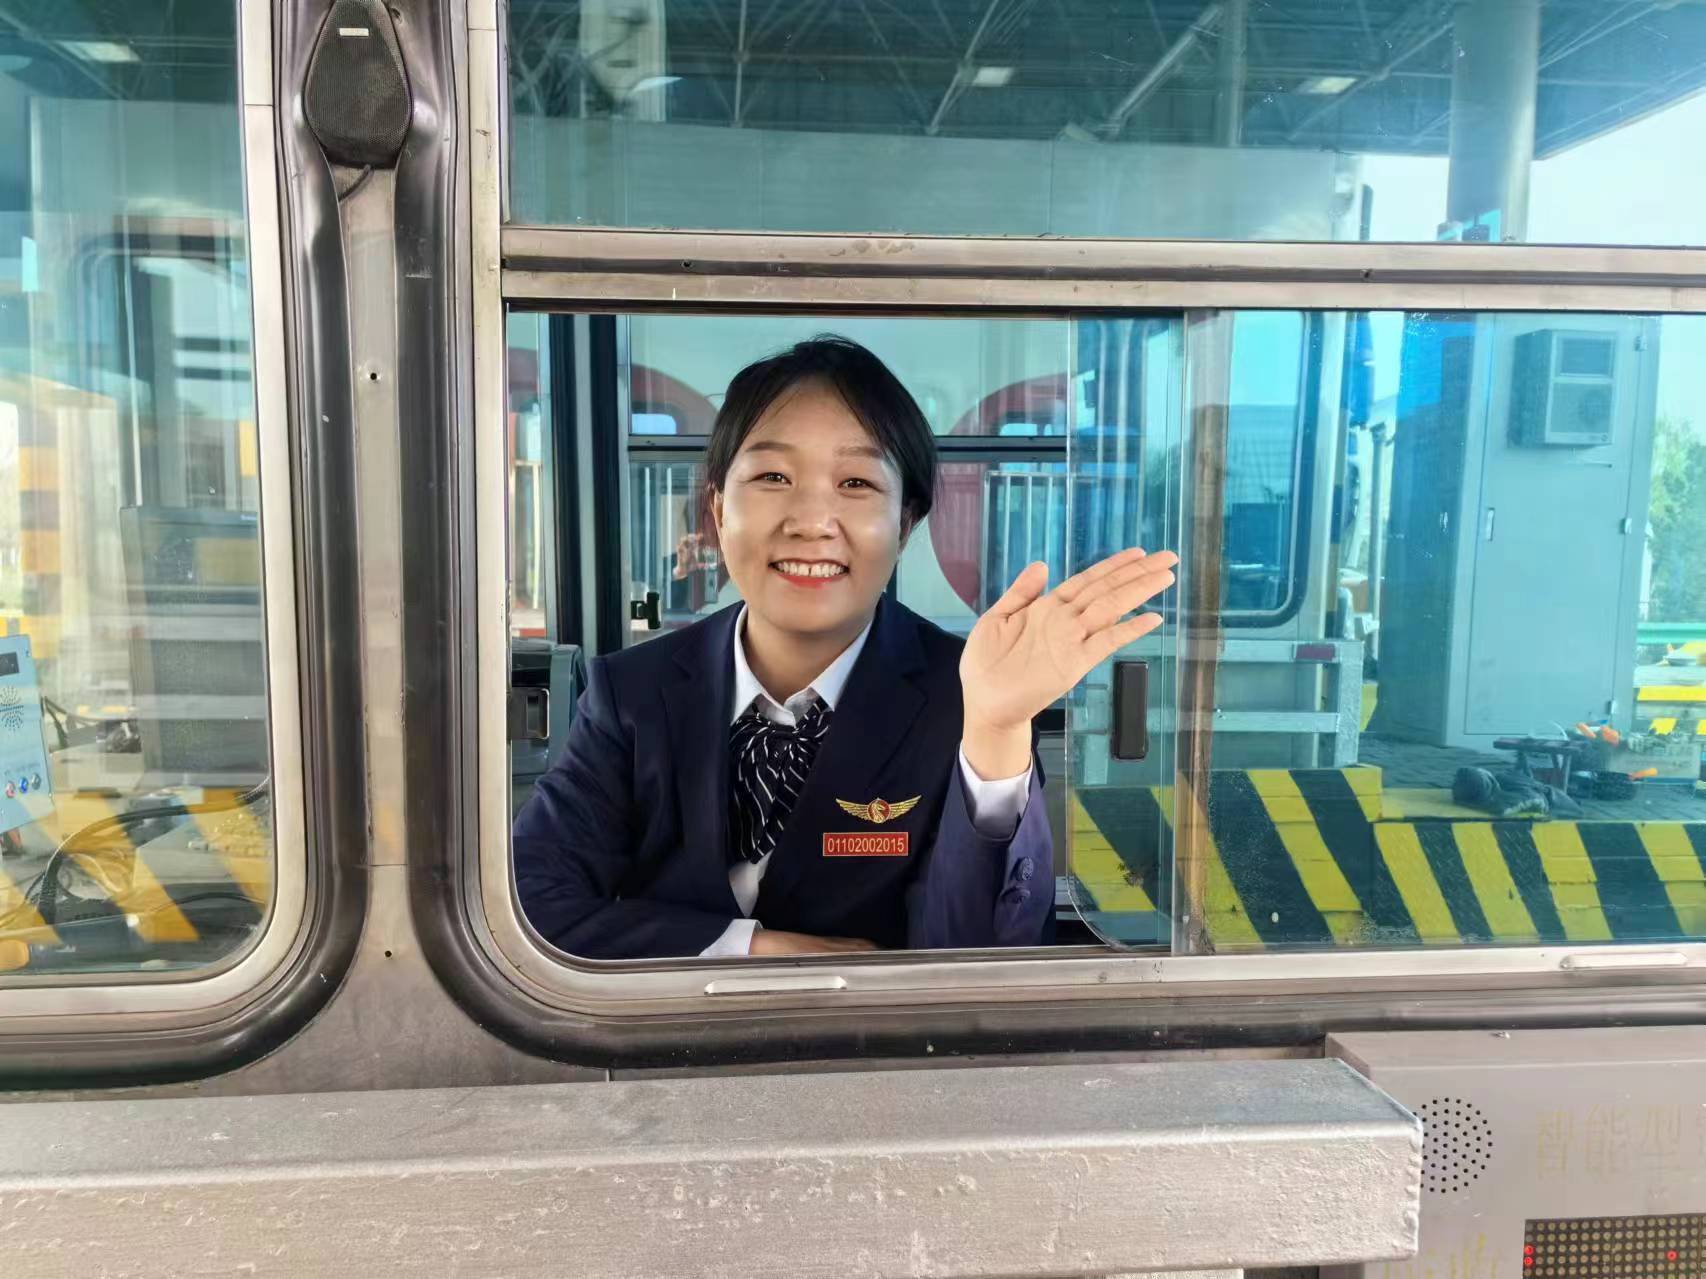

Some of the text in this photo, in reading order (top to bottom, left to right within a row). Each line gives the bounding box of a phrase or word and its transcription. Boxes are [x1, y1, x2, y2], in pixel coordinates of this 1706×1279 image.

[827, 837, 905, 853] 01102002015
[1537, 1104, 1706, 1178] 智能型
